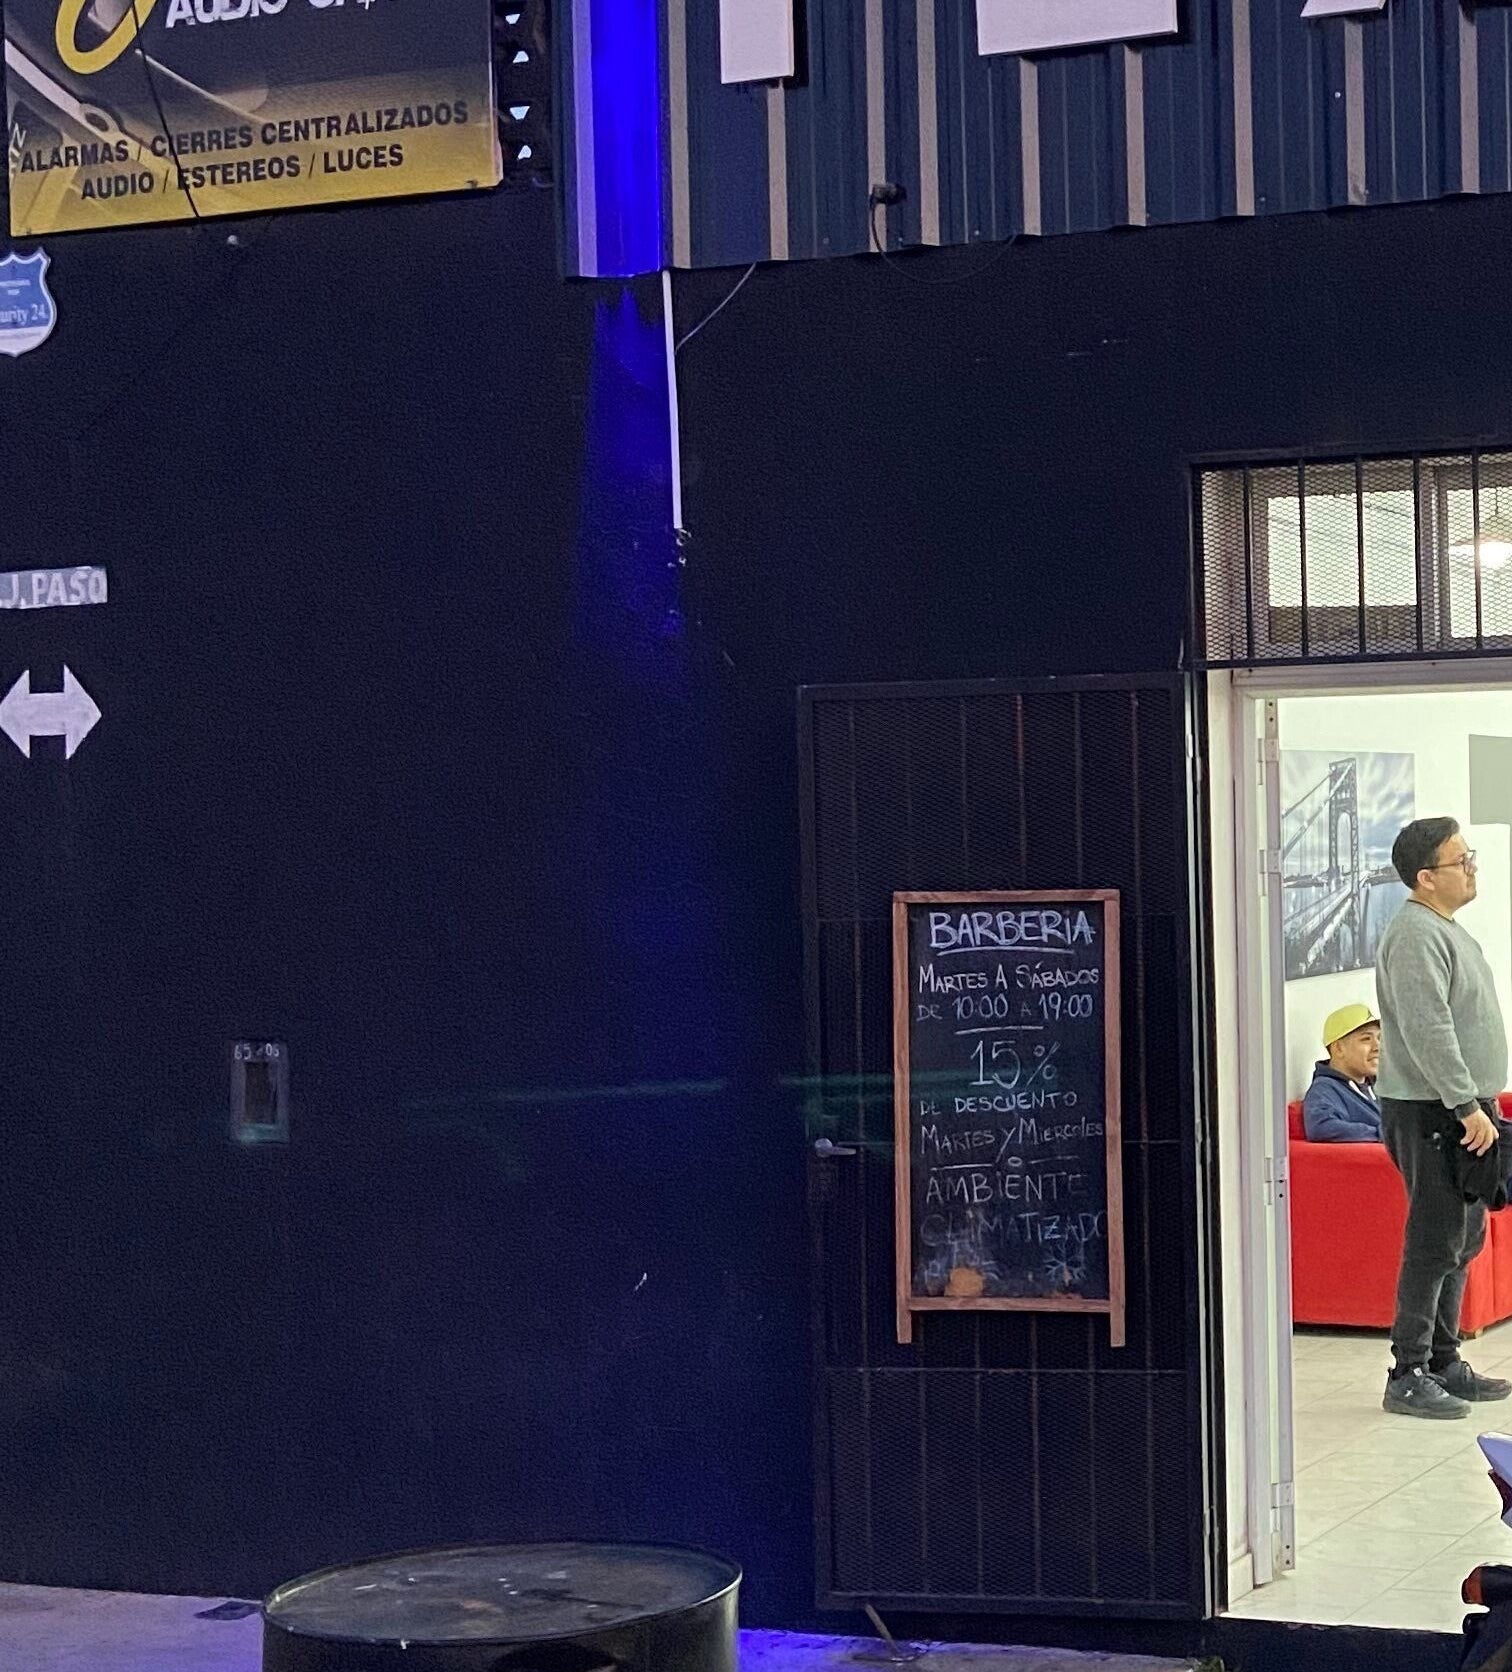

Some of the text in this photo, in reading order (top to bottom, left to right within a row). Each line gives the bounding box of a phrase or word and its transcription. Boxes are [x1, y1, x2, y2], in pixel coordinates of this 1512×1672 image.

[20, 139, 129, 173] ALARMAS
[151, 125, 253, 158] CIERRES
[261, 101, 469, 145] CENTRALIZADOS
[81, 172, 154, 201] AUDIO
[177, 155, 300, 190] ESTEREOS
[324, 144, 403, 174] LUCES
[996, 963, 1008, 990] A
[916, 1004, 943, 1021] DE
[952, 992, 1009, 1020] 10:00
[1039, 991, 1093, 1021] 19:00
[920, 1091, 1079, 1116] DE DESCUENTO
[926, 1172, 1088, 1203] AMBIENTE
